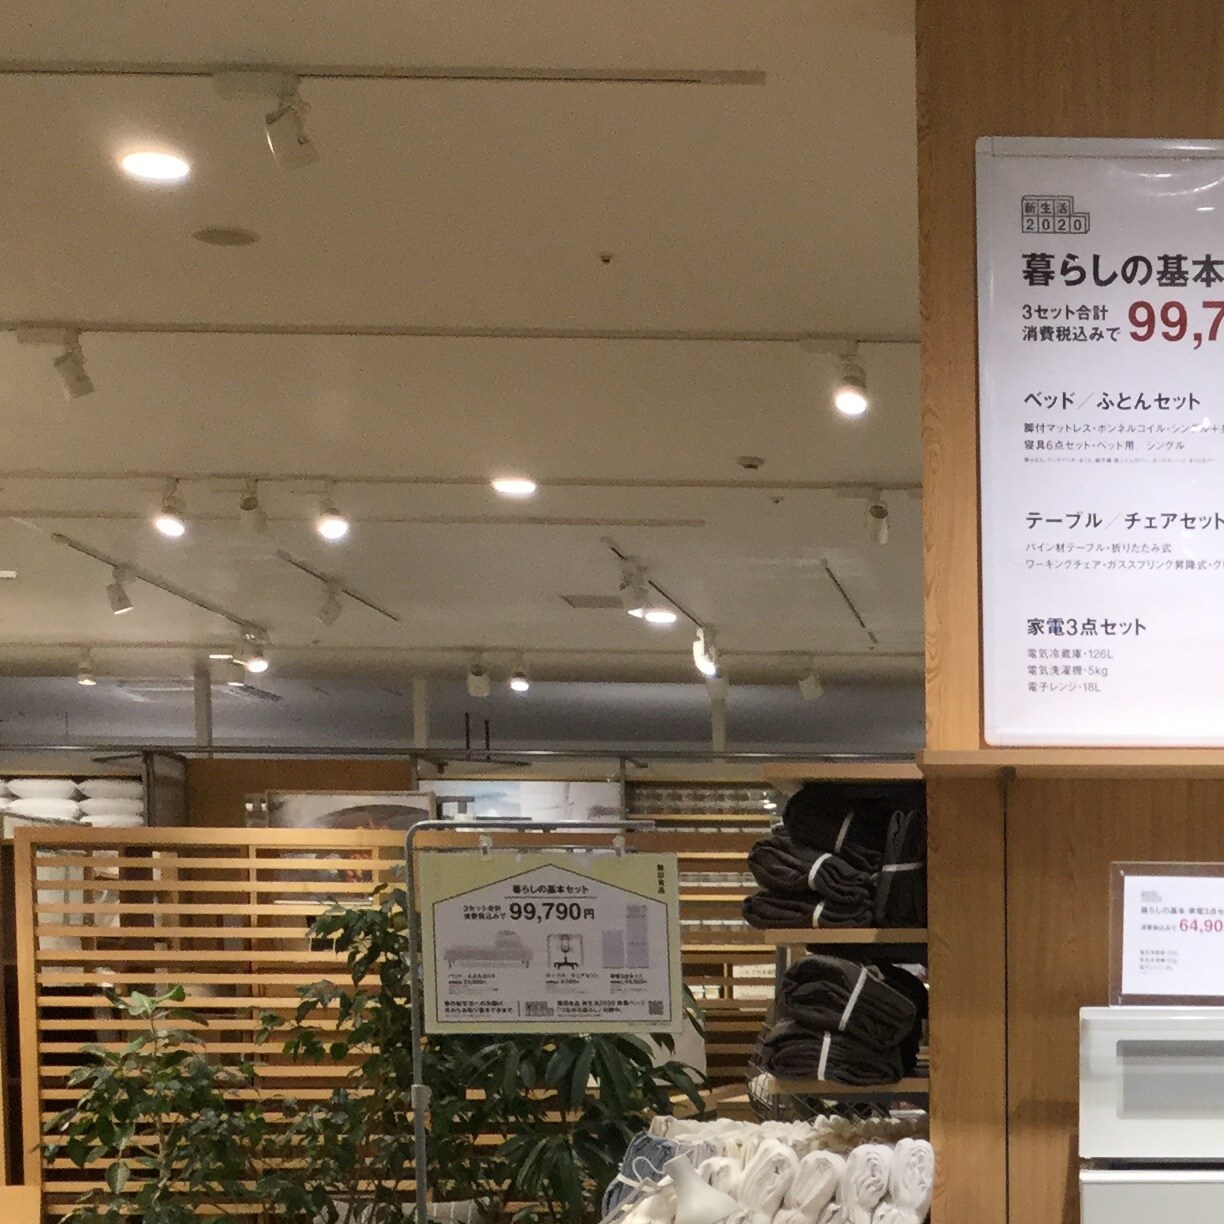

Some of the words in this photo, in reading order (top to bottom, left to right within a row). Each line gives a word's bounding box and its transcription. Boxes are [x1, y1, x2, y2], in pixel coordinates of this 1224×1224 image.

[1025, 202, 1068, 214] 新生活
[1026, 219, 1082, 231] 2020
[1022, 304, 1109, 321] 3セット合計
[1022, 326, 1121, 343] 消費税込みで
[1026, 618, 1147, 637] 家電3点セット
[509, 902, 596, 923] 99,790円
